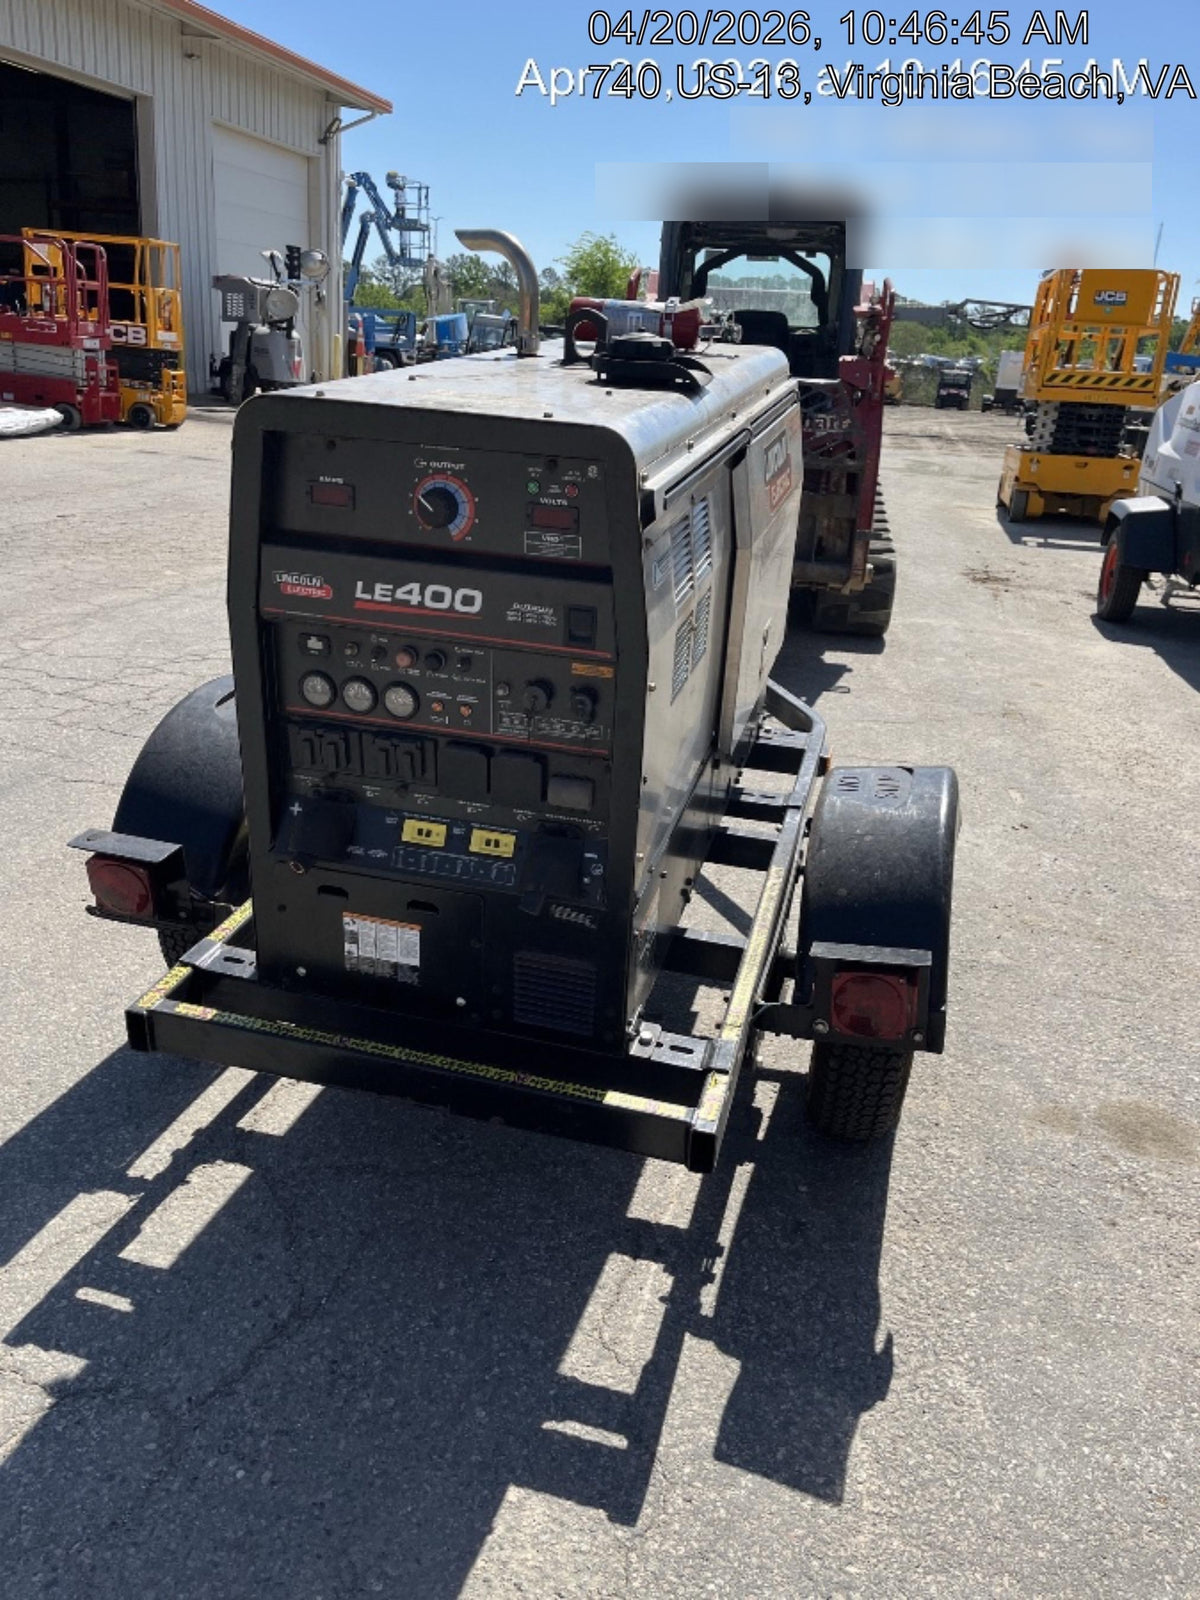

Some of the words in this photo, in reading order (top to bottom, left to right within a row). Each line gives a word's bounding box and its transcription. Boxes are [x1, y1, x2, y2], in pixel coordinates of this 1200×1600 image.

[1095, 290, 1127, 302] JCB
[275, 572, 322, 588] LINCOLN
[354, 580, 483, 614] LE400
